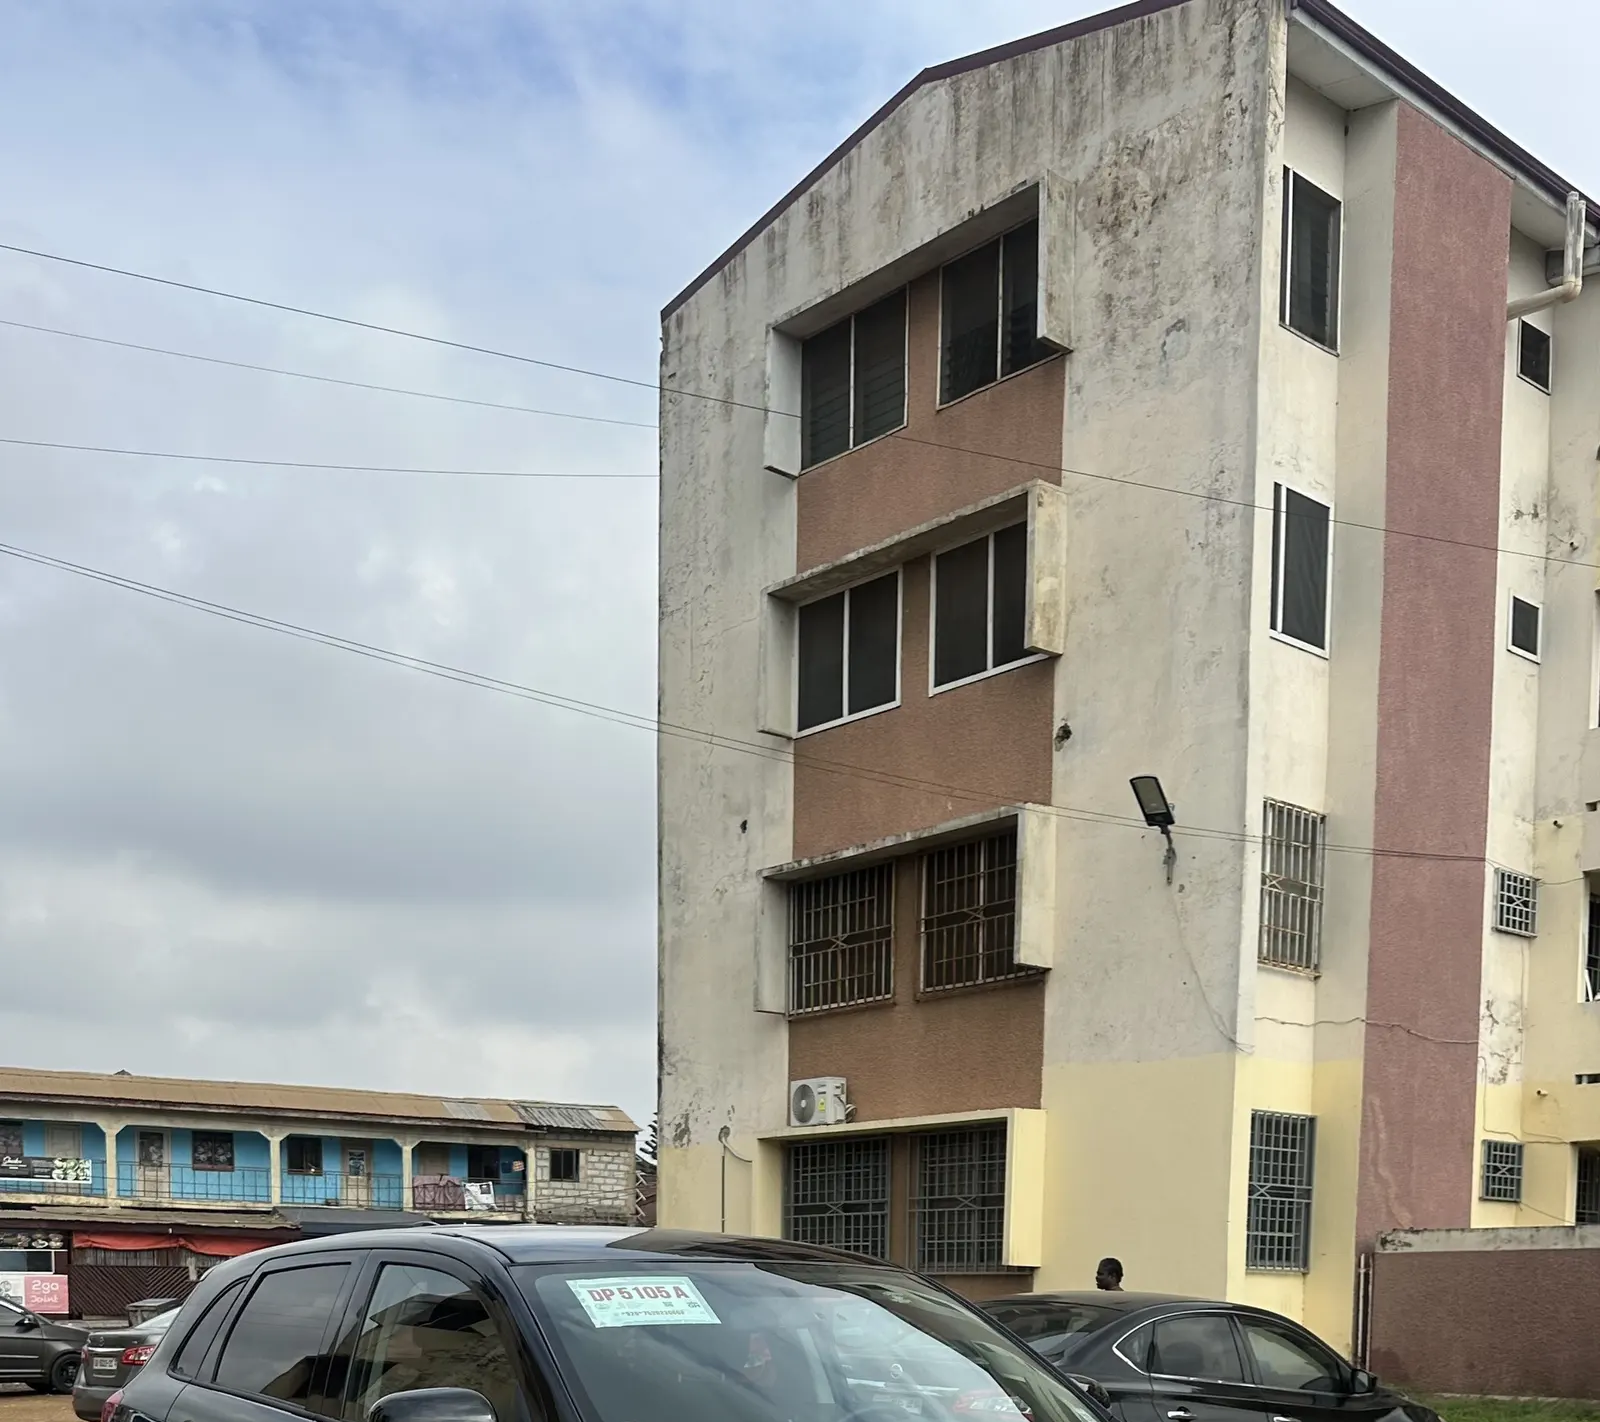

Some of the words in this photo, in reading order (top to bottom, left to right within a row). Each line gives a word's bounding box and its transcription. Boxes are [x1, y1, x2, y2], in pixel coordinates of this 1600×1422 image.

[31, 1279, 59, 1294] 2go
[587, 1288, 615, 1302] DP
[617, 1286, 671, 1300] 5105
[673, 1285, 689, 1299] A
